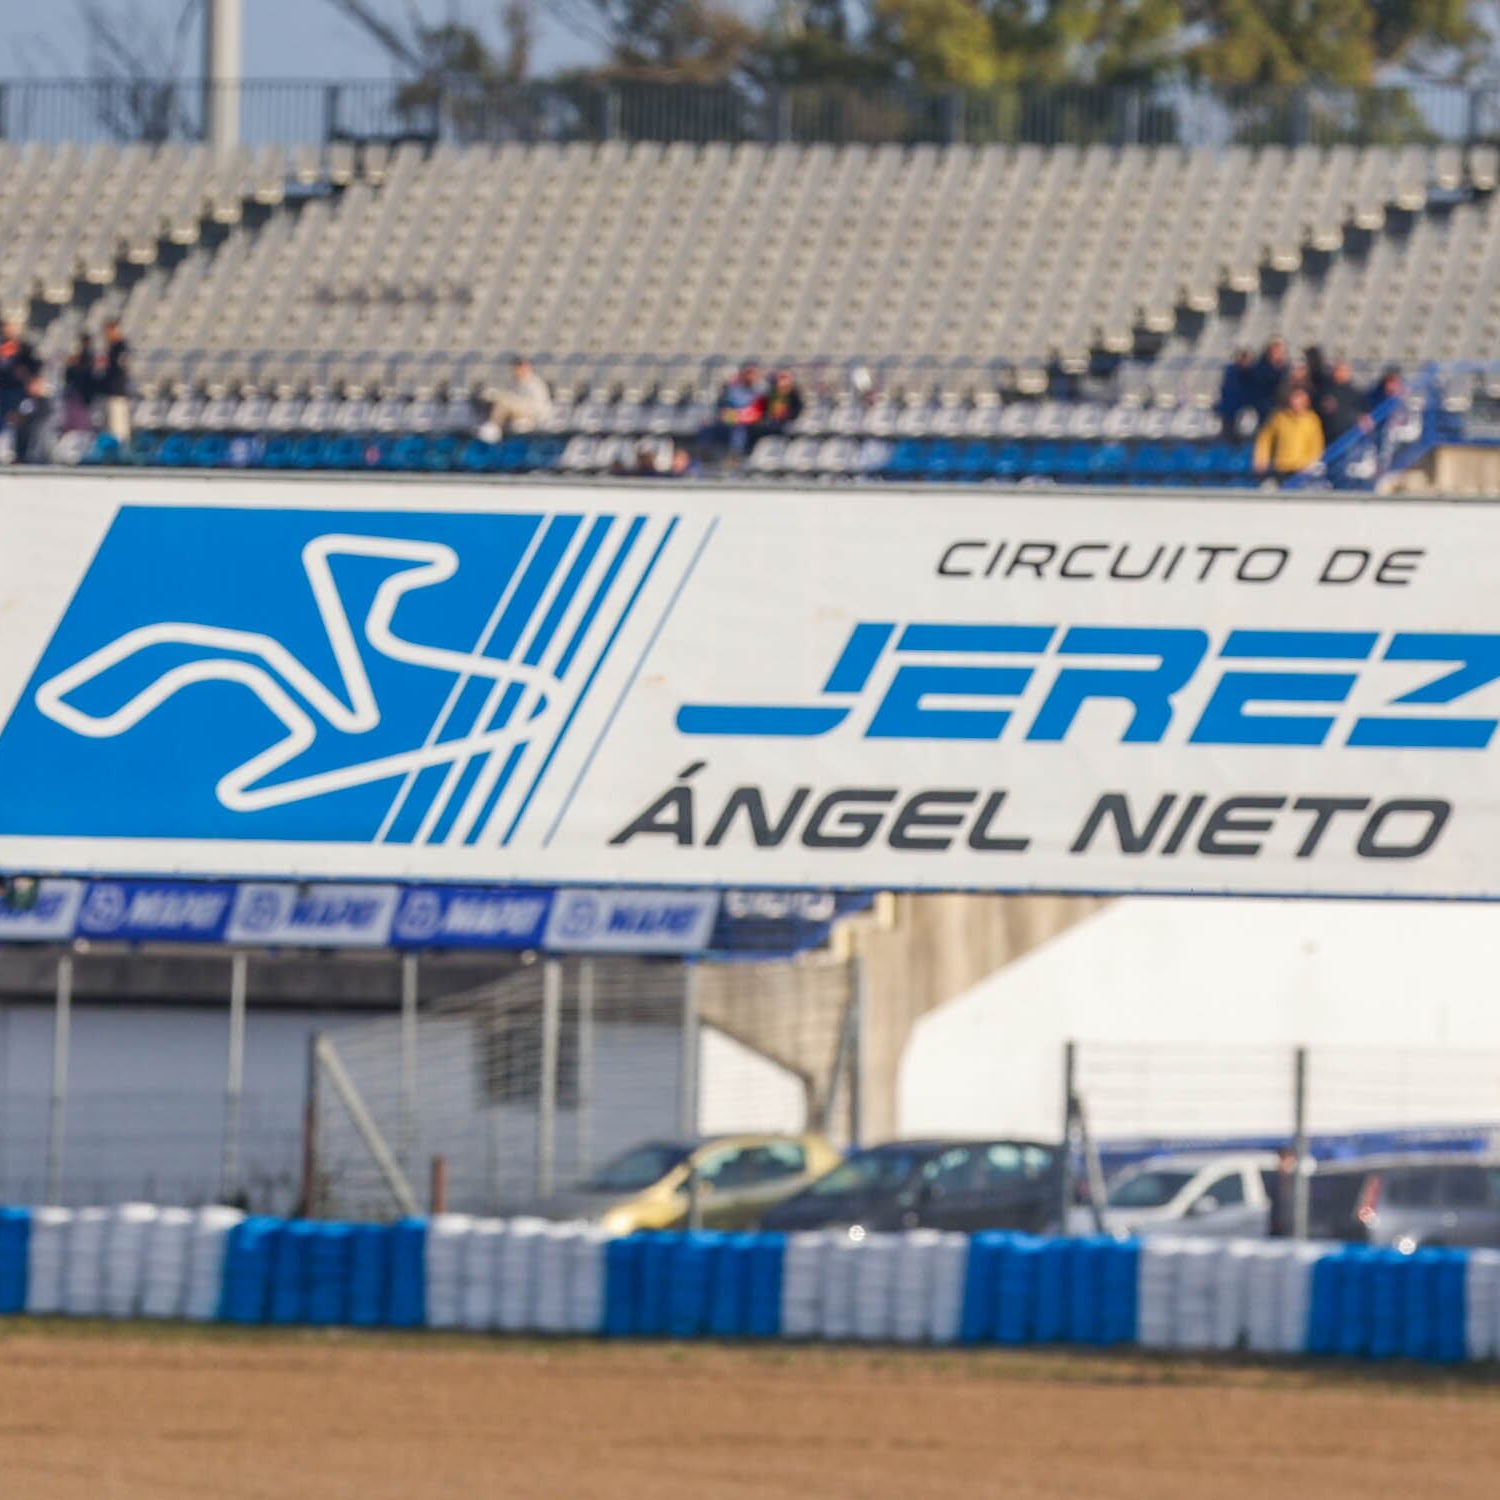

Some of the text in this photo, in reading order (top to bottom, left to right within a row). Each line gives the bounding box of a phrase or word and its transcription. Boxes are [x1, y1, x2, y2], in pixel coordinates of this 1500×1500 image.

[934, 539, 1426, 586] CIRCUITO DE
[607, 759, 1453, 859] ÁNGEL NIETO
